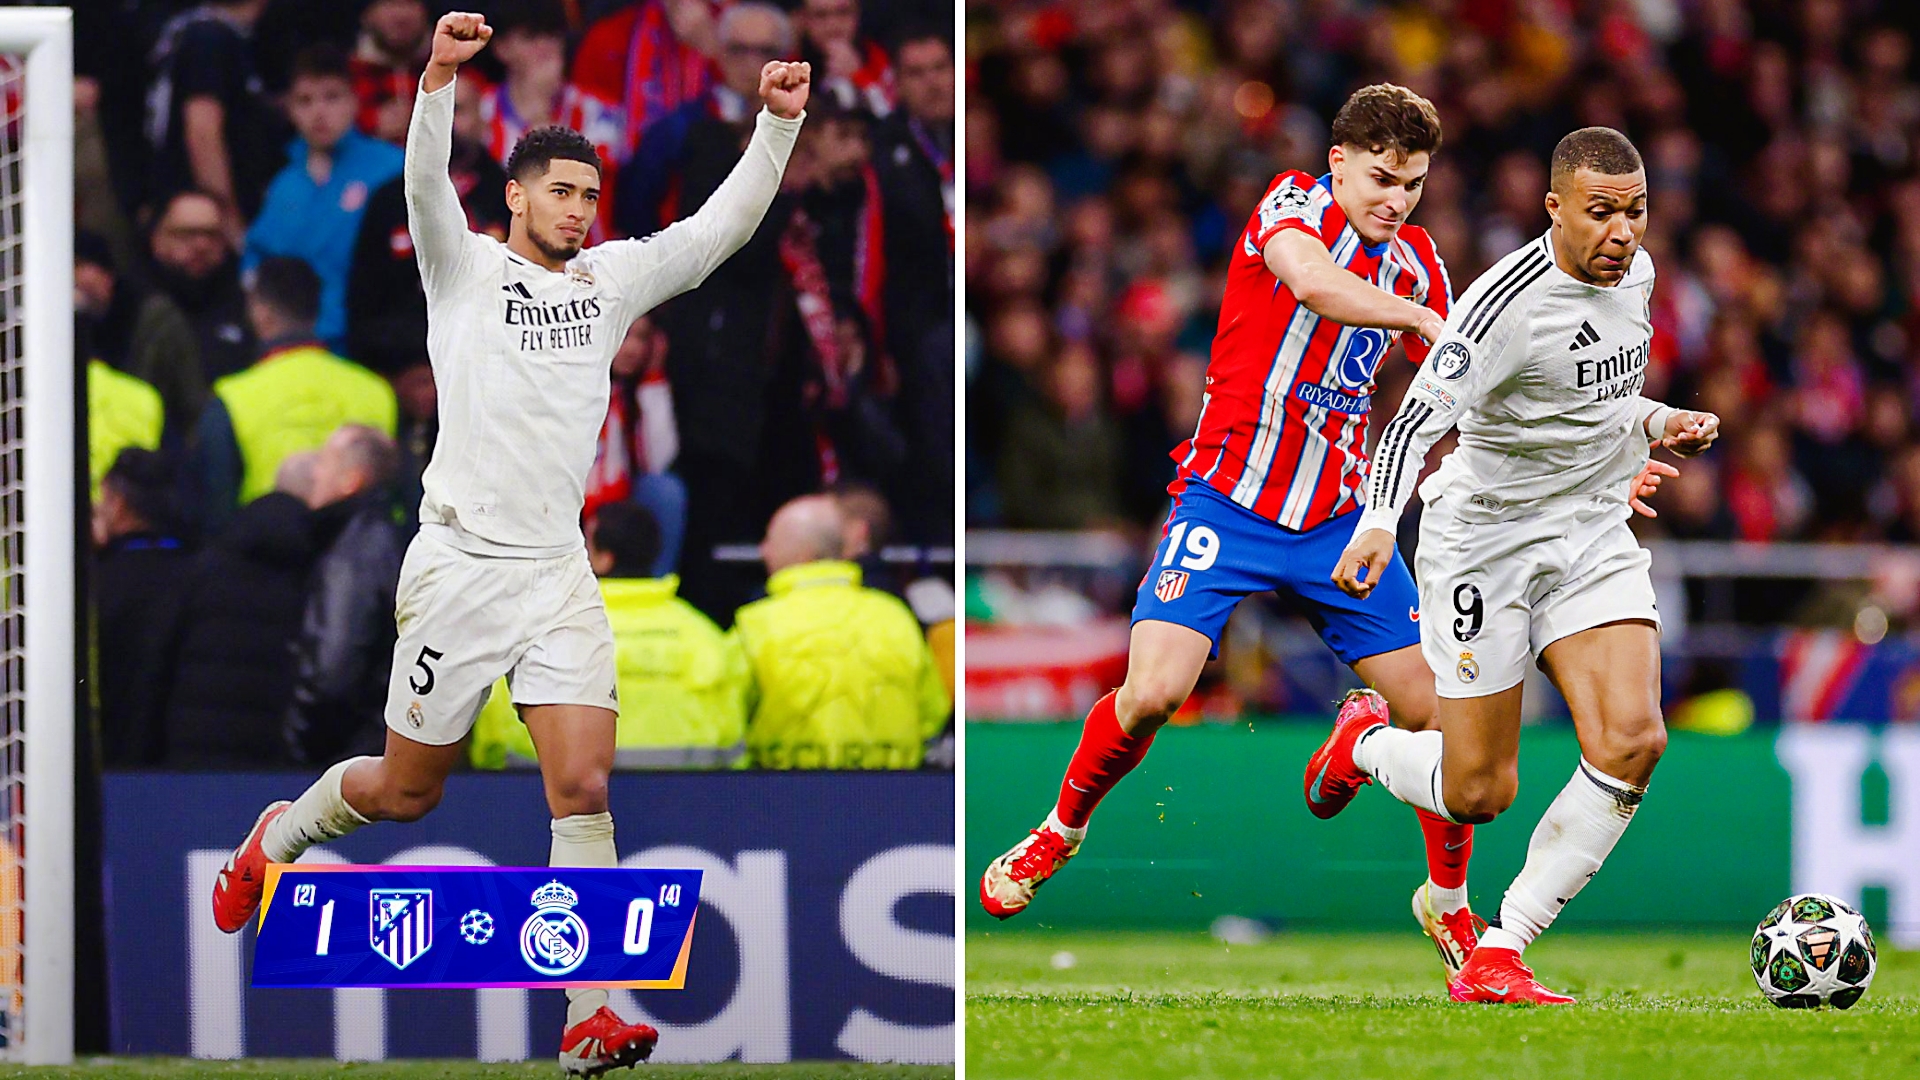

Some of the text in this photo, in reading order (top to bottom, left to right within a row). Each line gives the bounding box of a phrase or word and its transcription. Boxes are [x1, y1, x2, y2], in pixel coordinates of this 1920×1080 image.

[505, 296, 600, 326] Emirates
[520, 324, 592, 351] FLY BETTER
[1442, 357, 1456, 369] 15
[1575, 338, 1649, 388] Emirat
[1298, 383, 1358, 412] RIYADH
[1161, 521, 1220, 571] 19
[1453, 583, 1483, 642] 9
[409, 645, 444, 696] 5
